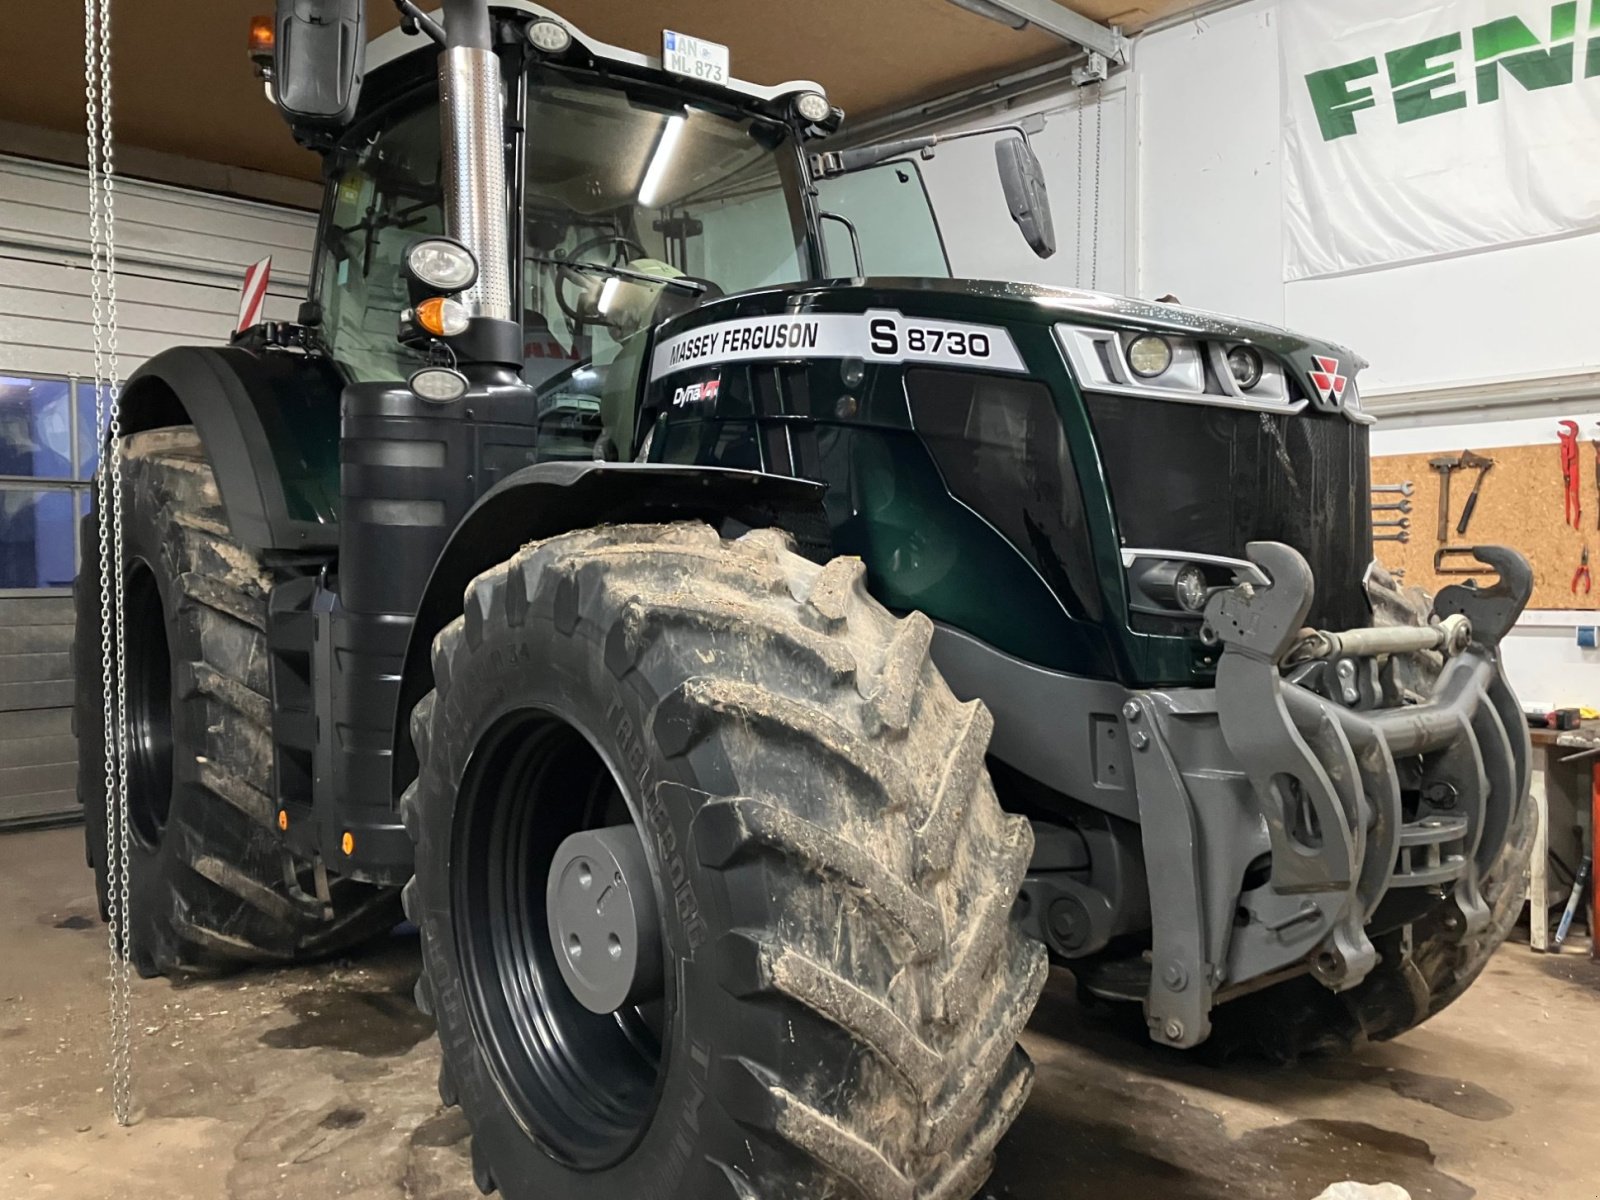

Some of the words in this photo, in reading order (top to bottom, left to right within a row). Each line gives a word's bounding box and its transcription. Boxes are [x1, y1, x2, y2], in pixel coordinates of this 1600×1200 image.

[677, 37, 697, 57] AN
[671, 54, 691, 74] ML
[695, 60, 722, 81] 873
[1304, 0, 1600, 142] FEN
[669, 332, 719, 366] MASSEY
[722, 322, 819, 354] FERGUSON
[870, 318, 899, 355] S
[907, 328, 990, 358] 8730
